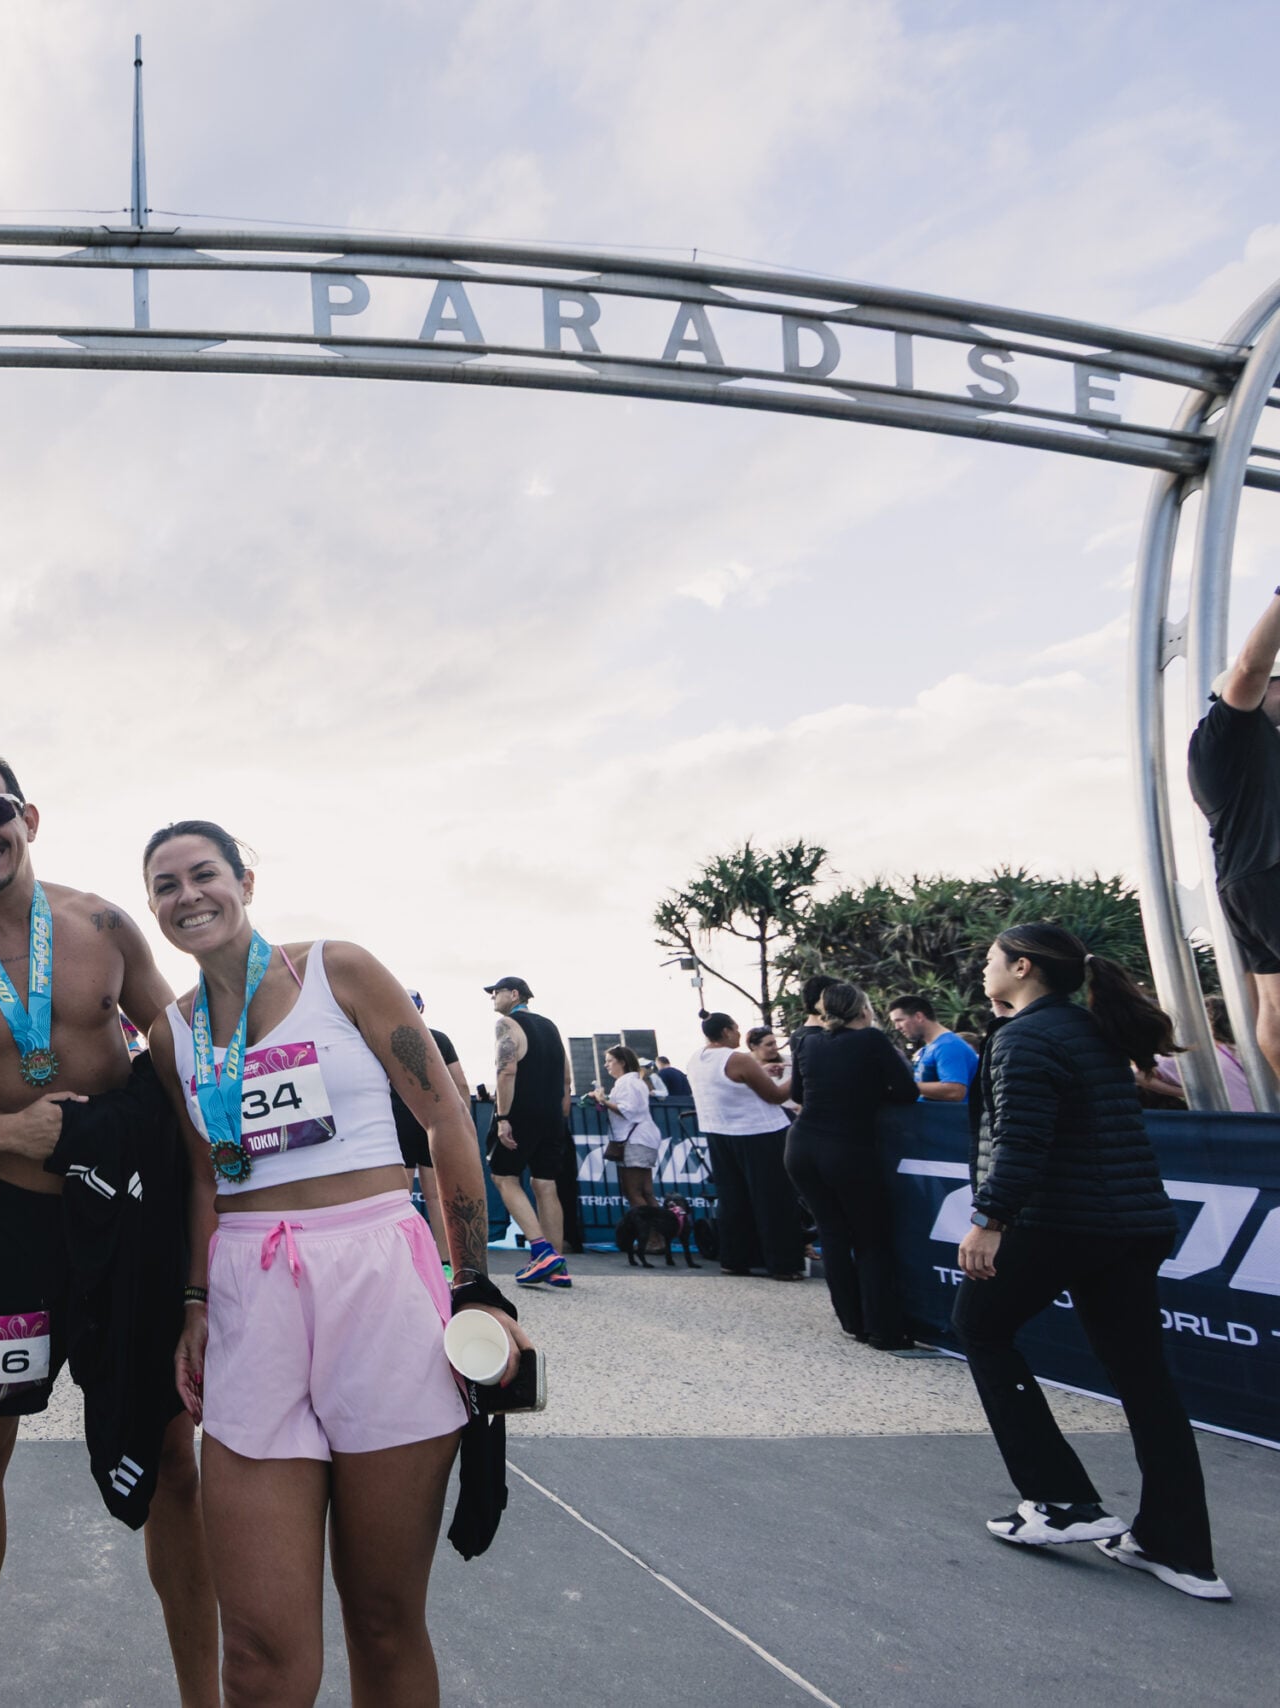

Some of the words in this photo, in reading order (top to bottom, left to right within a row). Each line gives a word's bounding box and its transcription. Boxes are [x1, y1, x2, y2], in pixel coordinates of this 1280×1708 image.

[311, 271, 1121, 426] PARADISE
[226, 1021, 242, 1080] T100
[242, 1082, 302, 1120] 34
[247, 1132, 280, 1151] 10KM
